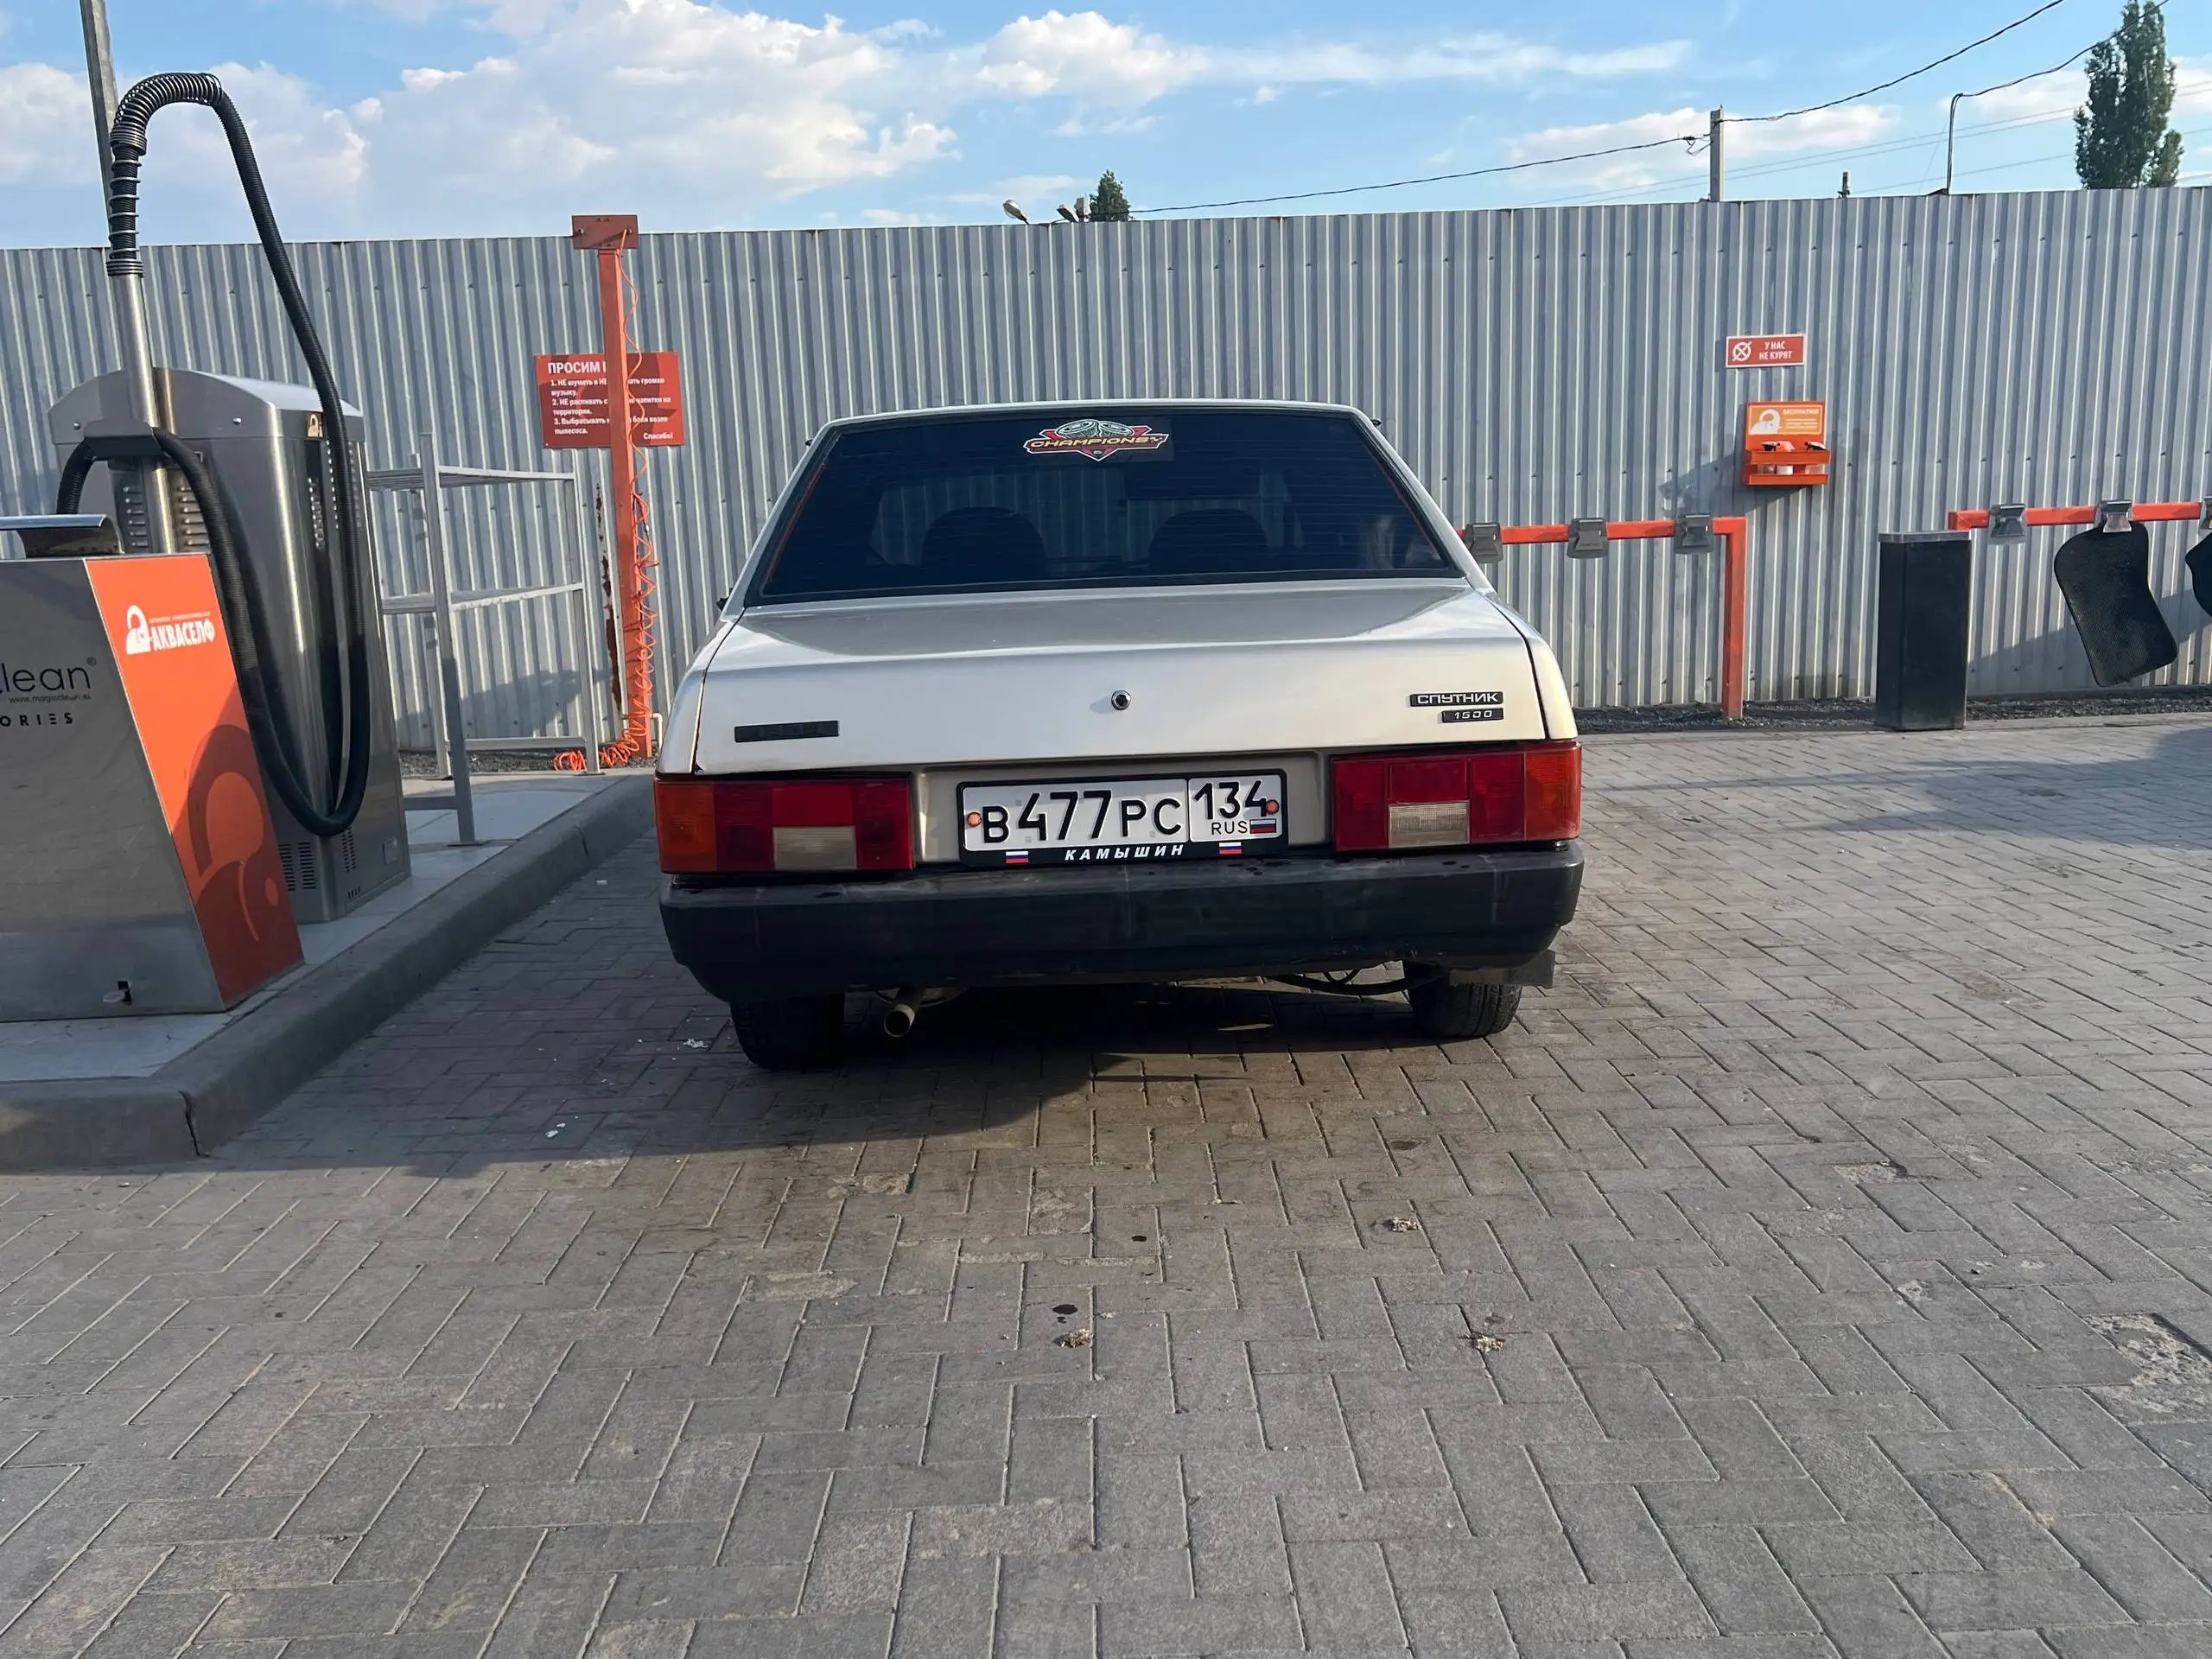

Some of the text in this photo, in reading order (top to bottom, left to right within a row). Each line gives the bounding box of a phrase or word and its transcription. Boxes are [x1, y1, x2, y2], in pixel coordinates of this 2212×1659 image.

[1764, 340, 1786, 350] У НАС
[1758, 351, 1793, 360] НЕ КУРЯТ
[547, 361, 601, 374] ПРОСИМ
[1030, 435, 1149, 448] CHAMPIONS
[151, 618, 216, 652] АКВАСЕЛФ
[0, 663, 92, 692] lean
[1417, 692, 1499, 704] СПУТНИК
[1454, 710, 1493, 720] 1500
[1193, 779, 1268, 820] 134
[1211, 820, 1249, 836] RUS
[1064, 844, 1184, 862] КАМЫШИН
